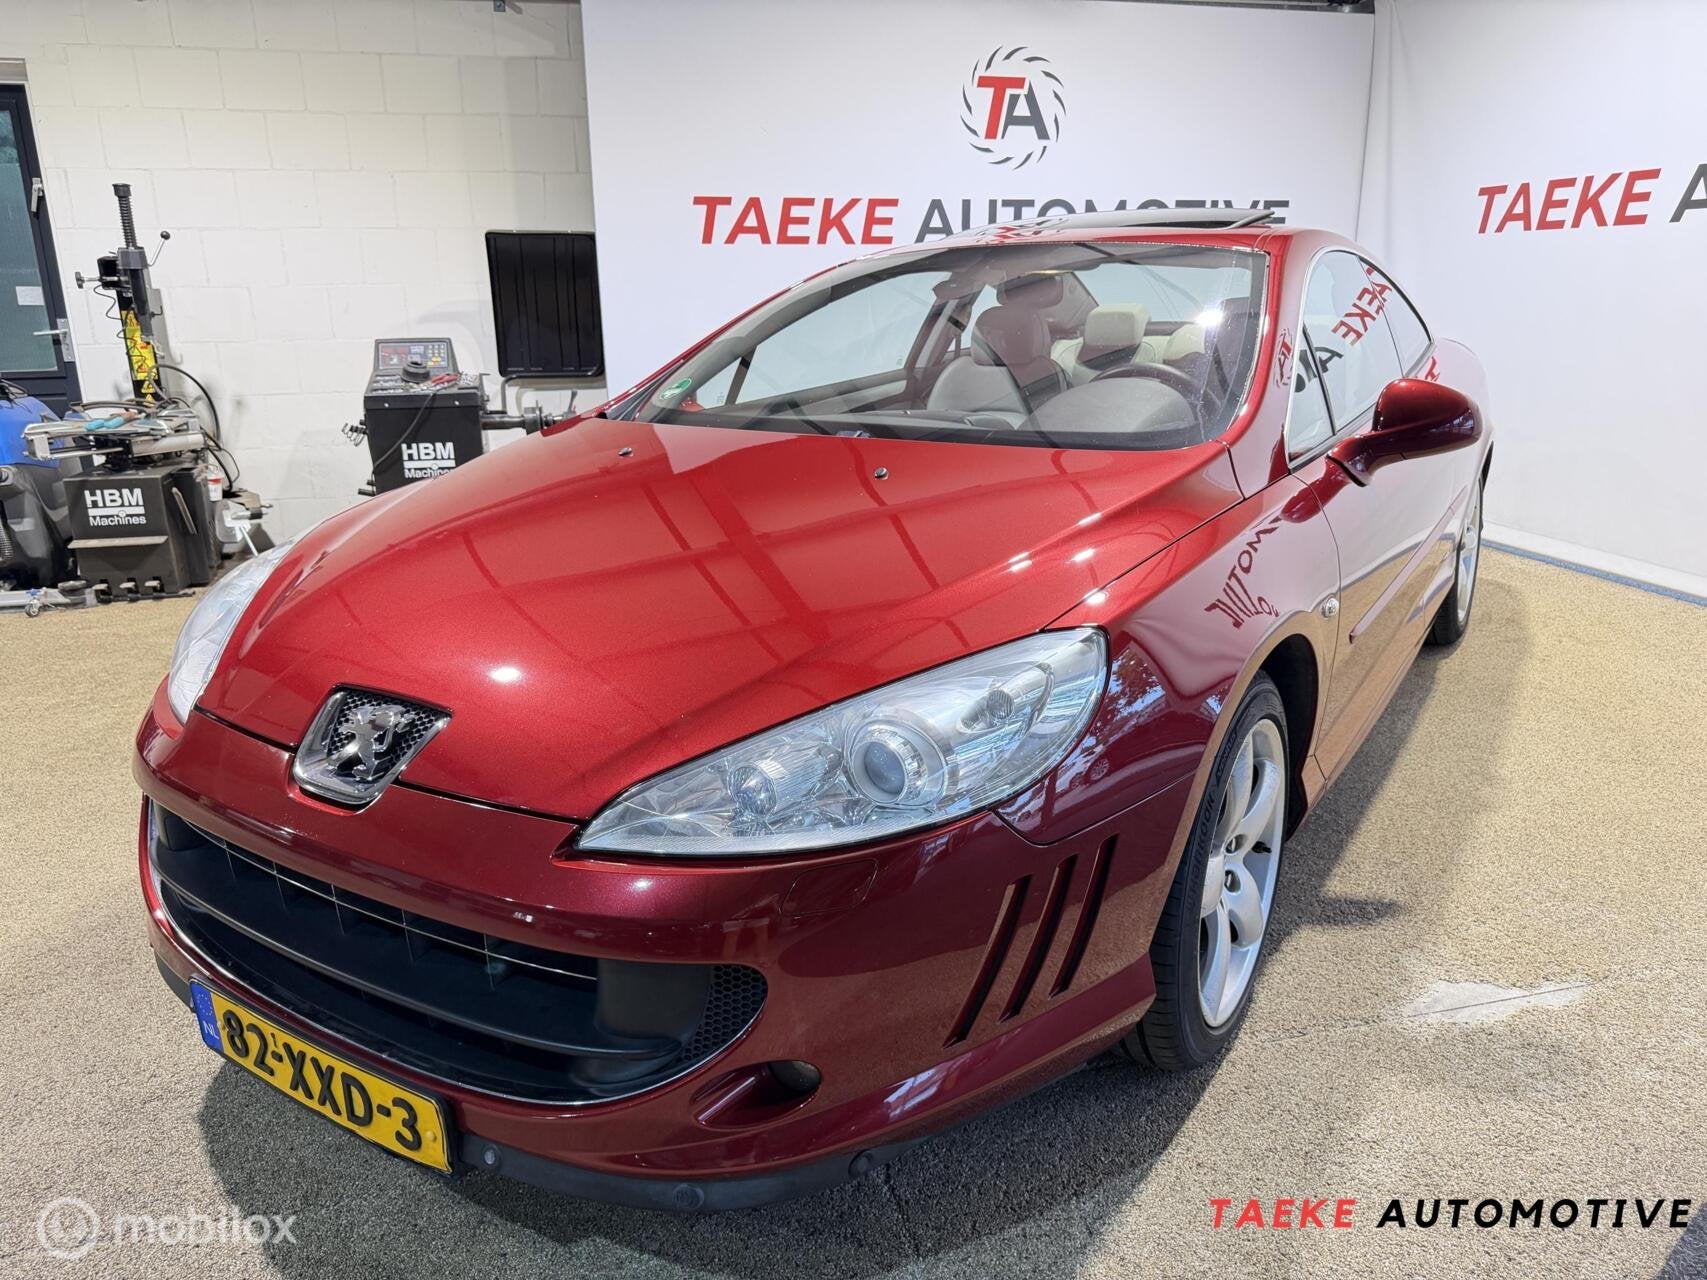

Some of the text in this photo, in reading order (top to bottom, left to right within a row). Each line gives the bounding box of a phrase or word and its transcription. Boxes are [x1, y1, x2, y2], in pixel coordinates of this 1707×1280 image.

[977, 76, 1050, 140] TA
[1477, 168, 1662, 234] TAEKE
[692, 196, 899, 245] TAEKE
[400, 442, 456, 461] HBM
[404, 466, 454, 479] Machine
[84, 488, 145, 508] HBM
[89, 515, 147, 527] Machines
[203, 1023, 220, 1041] NL
[222, 1009, 423, 1151] 82-XXD-3
